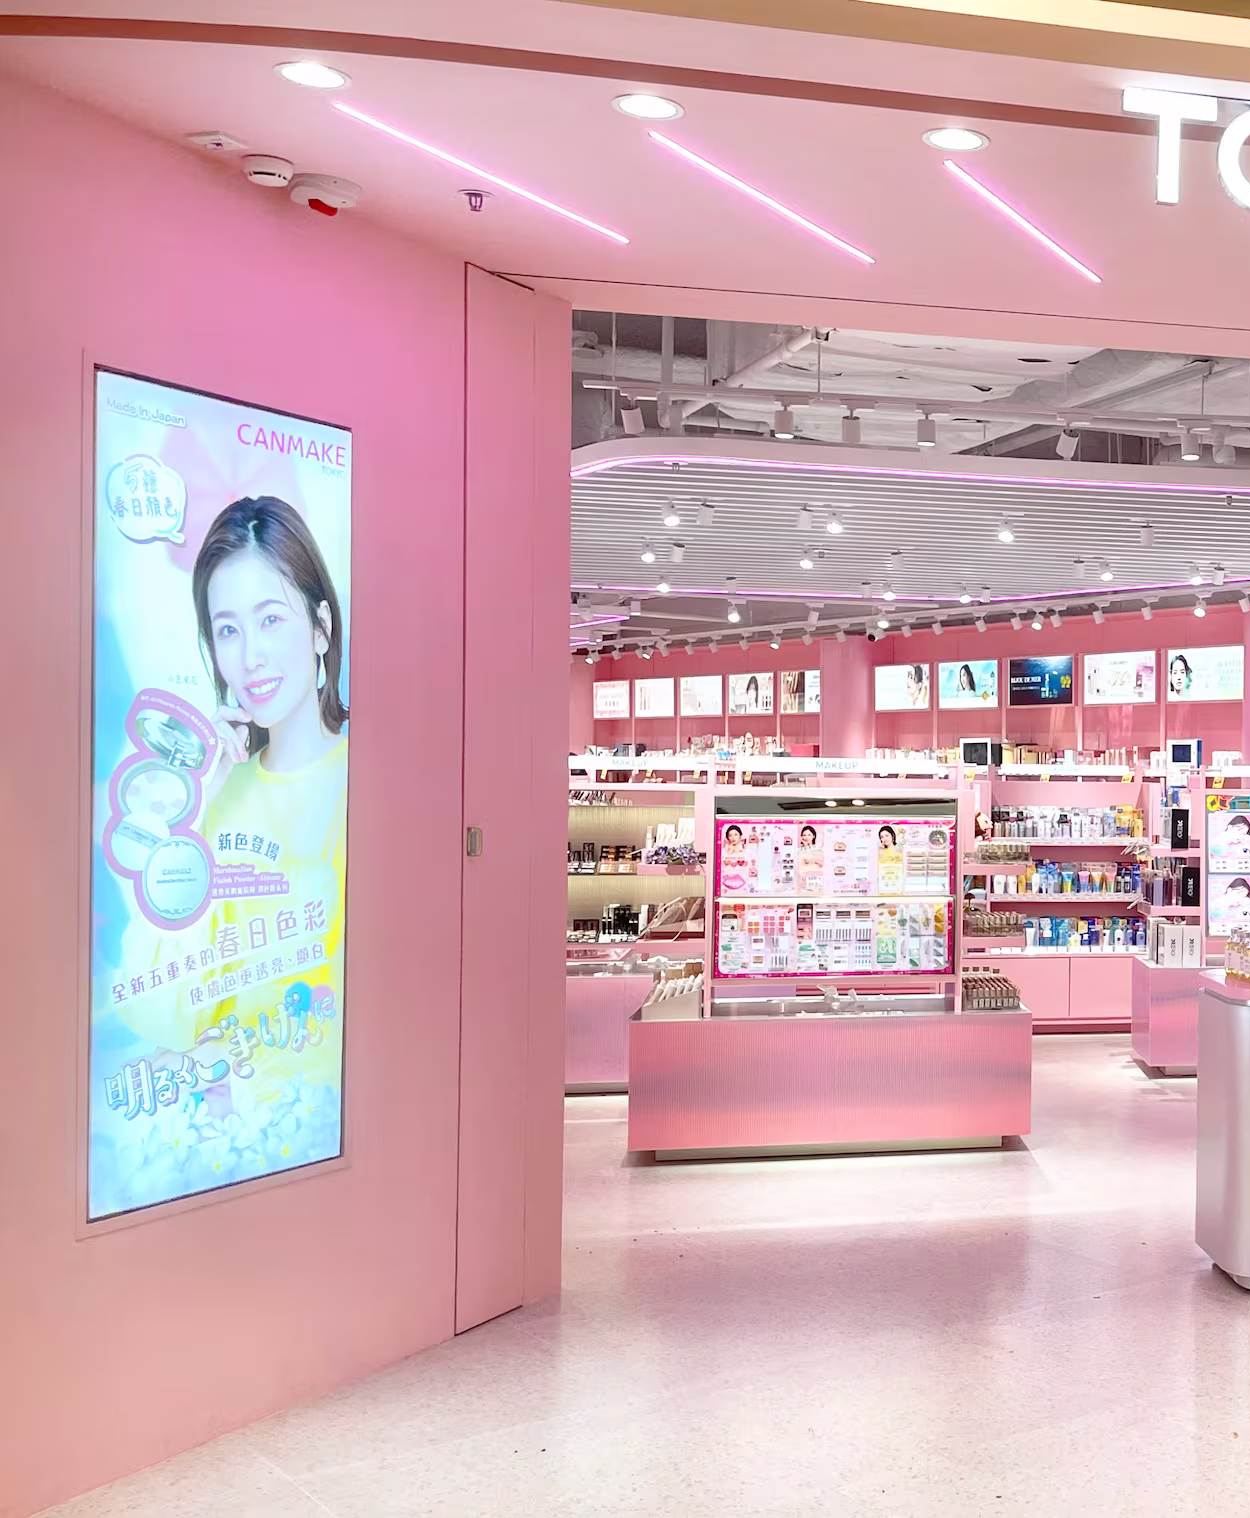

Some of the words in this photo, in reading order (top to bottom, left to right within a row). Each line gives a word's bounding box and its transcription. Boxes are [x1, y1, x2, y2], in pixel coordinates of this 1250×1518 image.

[106, 396, 136, 414] Made
[152, 409, 185, 426] Japan
[237, 423, 346, 467] CANMAKE
[815, 761, 858, 769] MAKEUP
[218, 832, 280, 861] 新色登場
